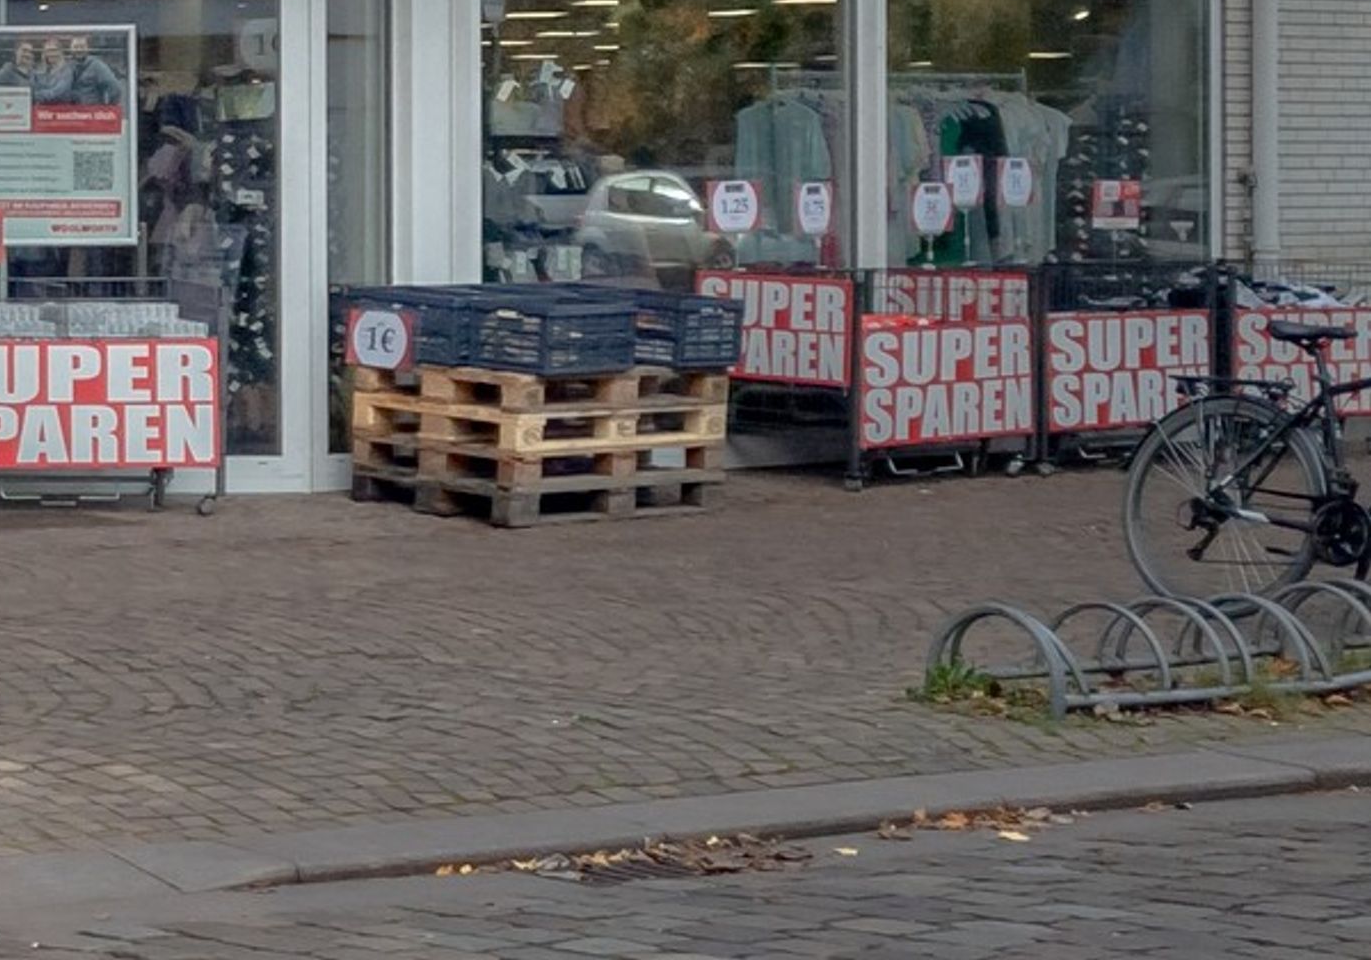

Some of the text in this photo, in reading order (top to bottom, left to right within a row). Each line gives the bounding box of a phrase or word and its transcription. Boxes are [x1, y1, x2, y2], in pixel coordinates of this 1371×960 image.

[365, 326, 397, 353] 1€
[741, 328, 846, 382] AREN
[864, 323, 1031, 388] SUPER
[1049, 314, 1209, 373] SUPER
[864, 376, 1032, 443] SPAREN
